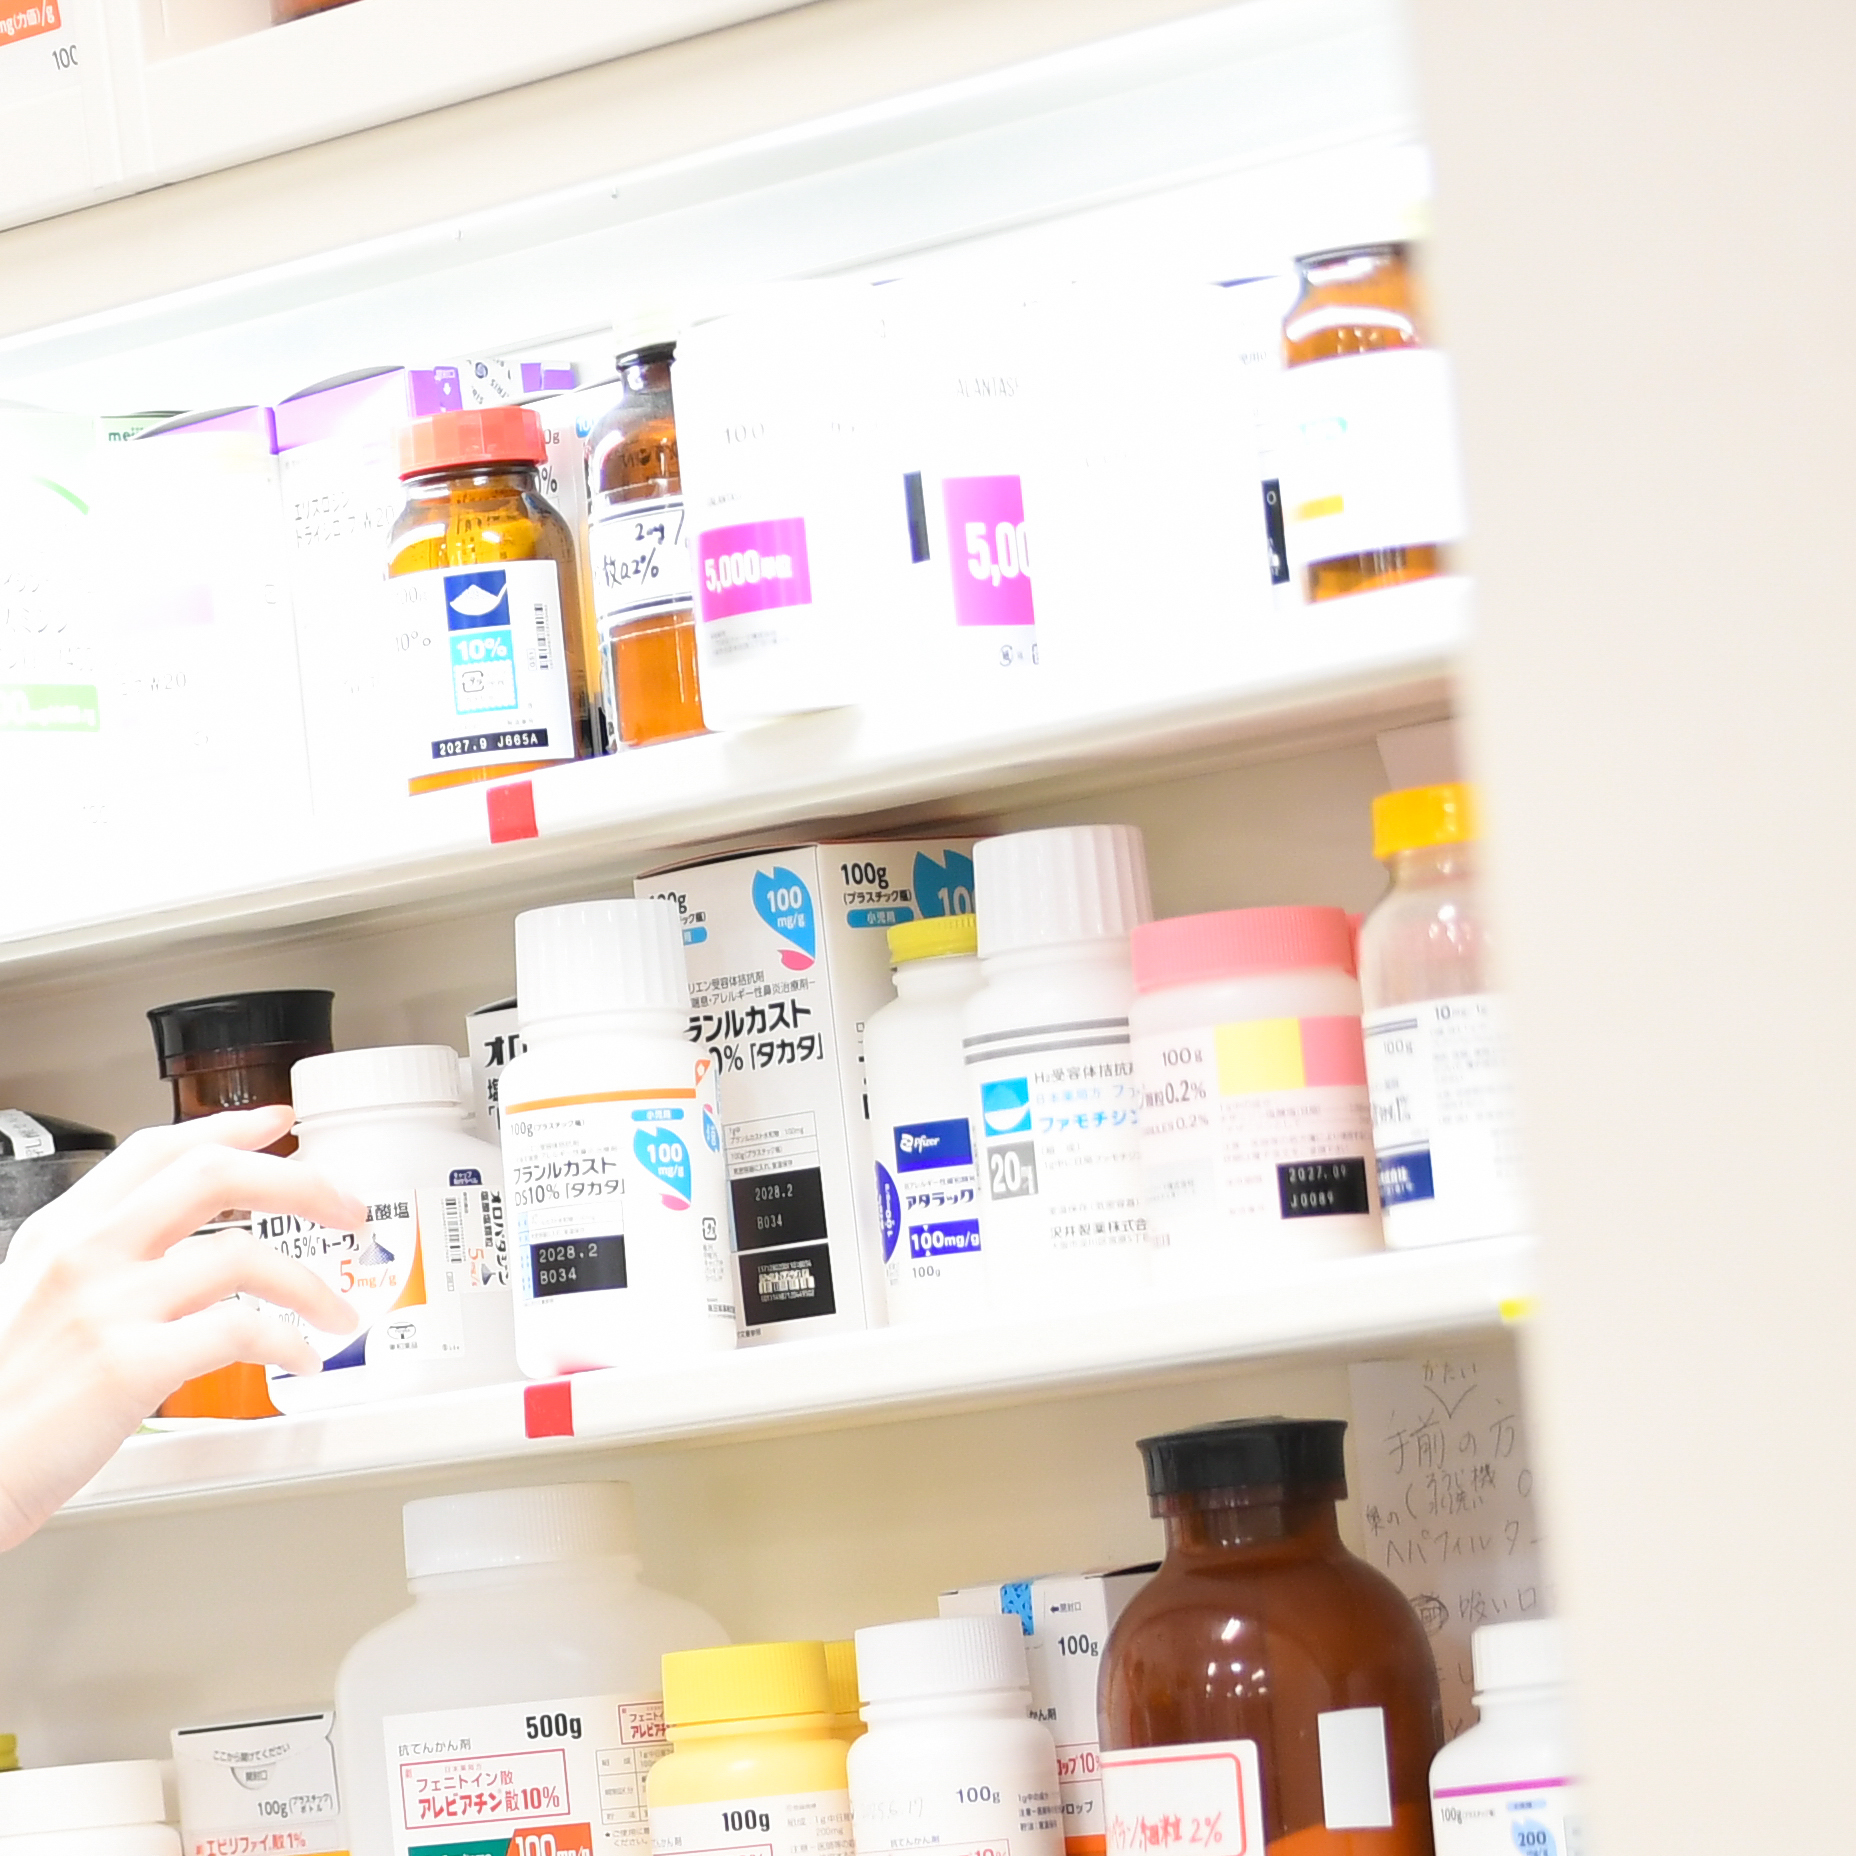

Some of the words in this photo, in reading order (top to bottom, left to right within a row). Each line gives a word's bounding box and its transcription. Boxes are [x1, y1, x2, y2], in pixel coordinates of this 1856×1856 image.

[704, 550, 760, 594] 5,000
[456, 636, 508, 661] 10%
[438, 736, 489, 757] 2027.9
[841, 860, 889, 888] 100g
[766, 886, 802, 912] 100
[777, 910, 806, 929] mg/g
[647, 1142, 683, 1164] 100
[914, 1134, 941, 1151] Pfizer
[513, 1157, 618, 1187] プランルカスト
[657, 1163, 684, 1180] mg/g
[755, 1184, 794, 1201] 2028.2
[757, 1215, 784, 1230] B034
[910, 1224, 981, 1252] 100mg/g
[539, 1243, 599, 1265] 2028.2
[340, 1258, 398, 1294] 5mg/g
[540, 1267, 578, 1285] B034
[912, 1264, 942, 1279] 100g
[1423, 1360, 1478, 1382] かたい
[1057, 1634, 1099, 1657] 100g
[526, 1712, 583, 1740] 500g
[398, 1738, 472, 1757] 抗てんかん剤
[416, 1768, 514, 1795] フェニトイン散
[955, 1786, 1002, 1805] 100g
[257, 1801, 289, 1819] 100g
[722, 1808, 771, 1833] 100g
[890, 1834, 941, 1848] 抗てんかん剤
[1190, 1812, 1223, 1848] 2%
[1518, 1830, 1548, 1848] 200
